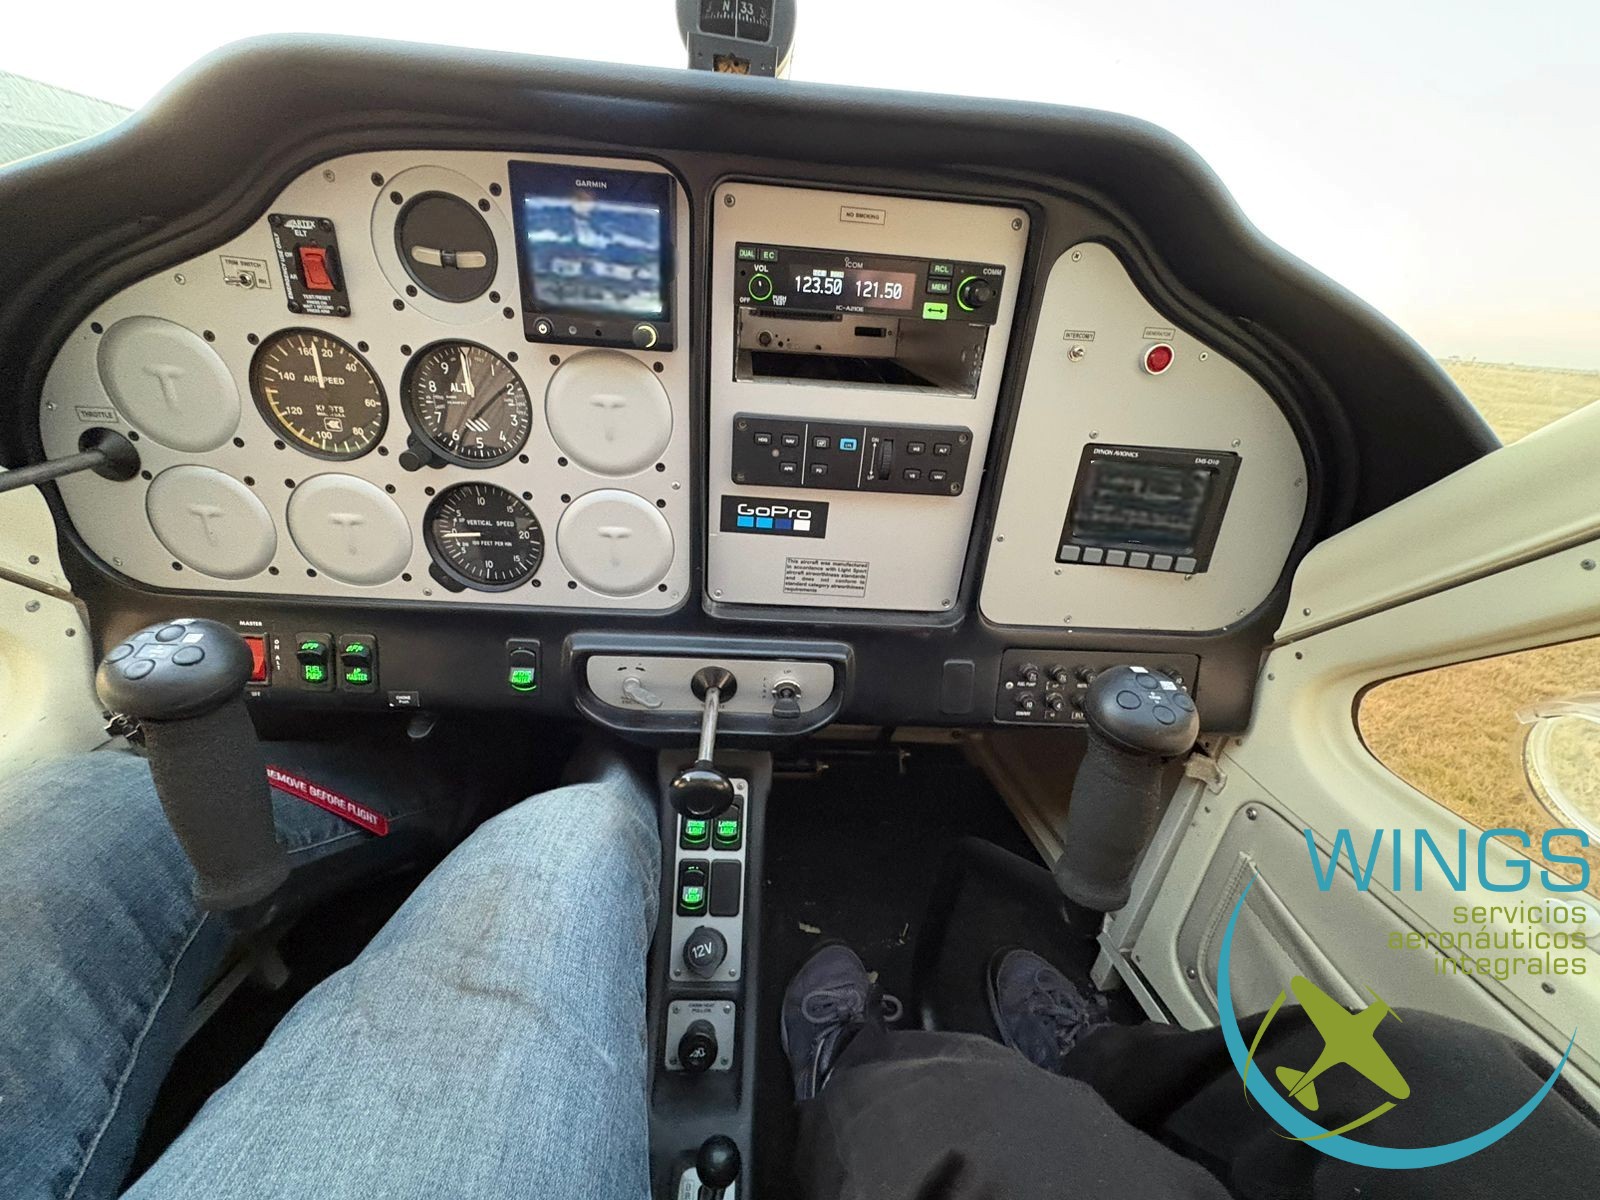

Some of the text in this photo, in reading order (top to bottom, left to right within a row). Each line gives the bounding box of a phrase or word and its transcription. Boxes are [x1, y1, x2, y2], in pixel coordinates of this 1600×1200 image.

[722, 0, 731, 11] N
[740, 2, 754, 15] 33
[575, 179, 607, 189] GARMIN
[856, 212, 880, 220] SMOKING
[294, 229, 307, 237] ELT
[739, 249, 775, 259] DUAL EC
[754, 264, 769, 272] VOL
[934, 264, 949, 274] RCL
[983, 267, 1002, 275] COMM
[795, 275, 843, 296] 123.50
[856, 280, 902, 300] 121.50
[931, 283, 947, 291] MEM
[298, 347, 314, 357] 160
[321, 348, 333, 358] 20
[345, 363, 357, 372] 40
[441, 362, 449, 374] 9
[278, 371, 296, 381] 140
[428, 381, 437, 392] 8
[450, 382, 467, 393] ALT
[506, 383, 515, 396] 2
[364, 398, 377, 408] 60
[286, 406, 303, 415] 120
[433, 411, 442, 423] 7
[510, 415, 519, 426] 3
[316, 430, 333, 440] 100
[352, 427, 364, 436] 80
[452, 429, 460, 441] 6
[499, 430, 507, 442] 4
[476, 437, 484, 449] 5
[1114, 449, 1139, 457] AVIONICS
[477, 496, 486, 506] 10
[506, 505, 515, 513] 15
[737, 503, 812, 519] GoPro
[467, 519, 515, 528] VERTICAL SPEED
[518, 530, 530, 540] 20
[485, 560, 494, 568] 10
[346, 673, 368, 681] MASTER
[309, 785, 346, 810] BEFORE
[347, 802, 378, 825] FLIGHT
[692, 942, 712, 958] 12V
